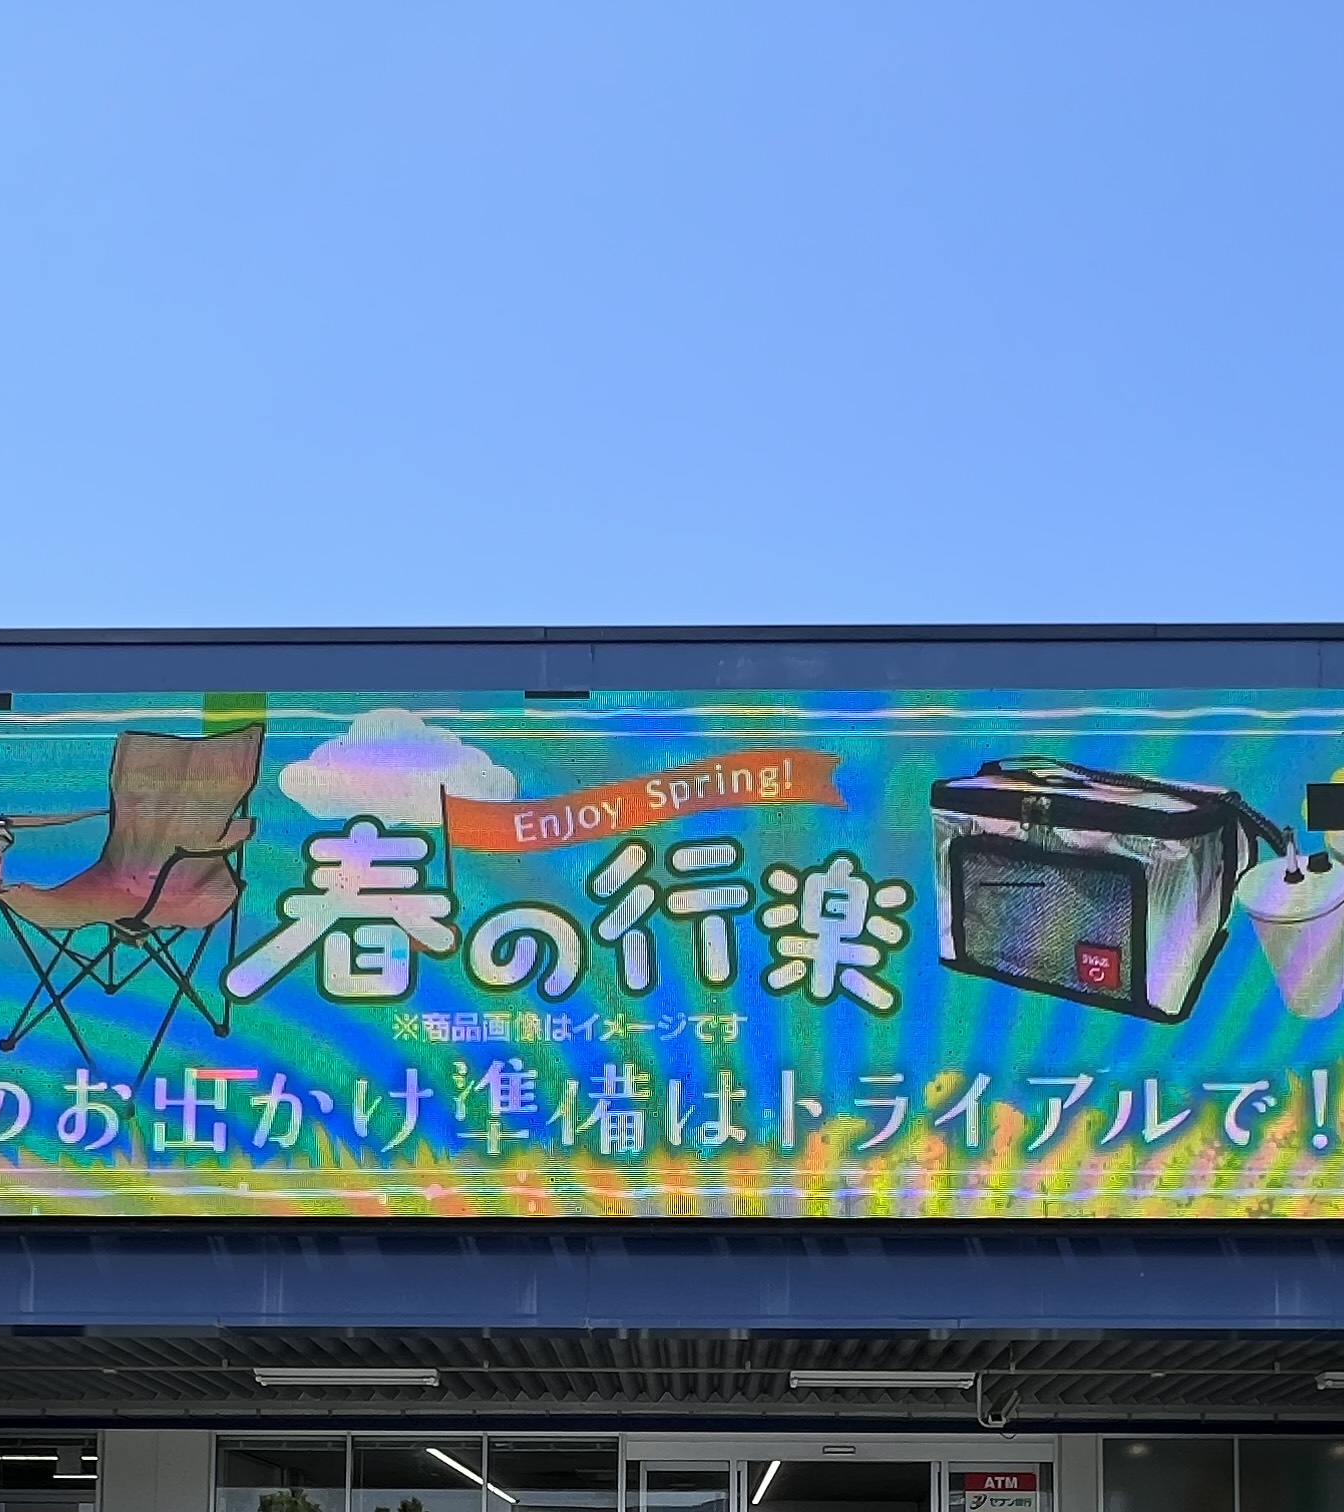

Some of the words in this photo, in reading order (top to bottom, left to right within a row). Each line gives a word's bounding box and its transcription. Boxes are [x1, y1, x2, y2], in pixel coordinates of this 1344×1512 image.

[645, 757, 793, 810] Spring!
[222, 817, 912, 1013] 春の行楽
[984, 1476, 1019, 1490] ATM
